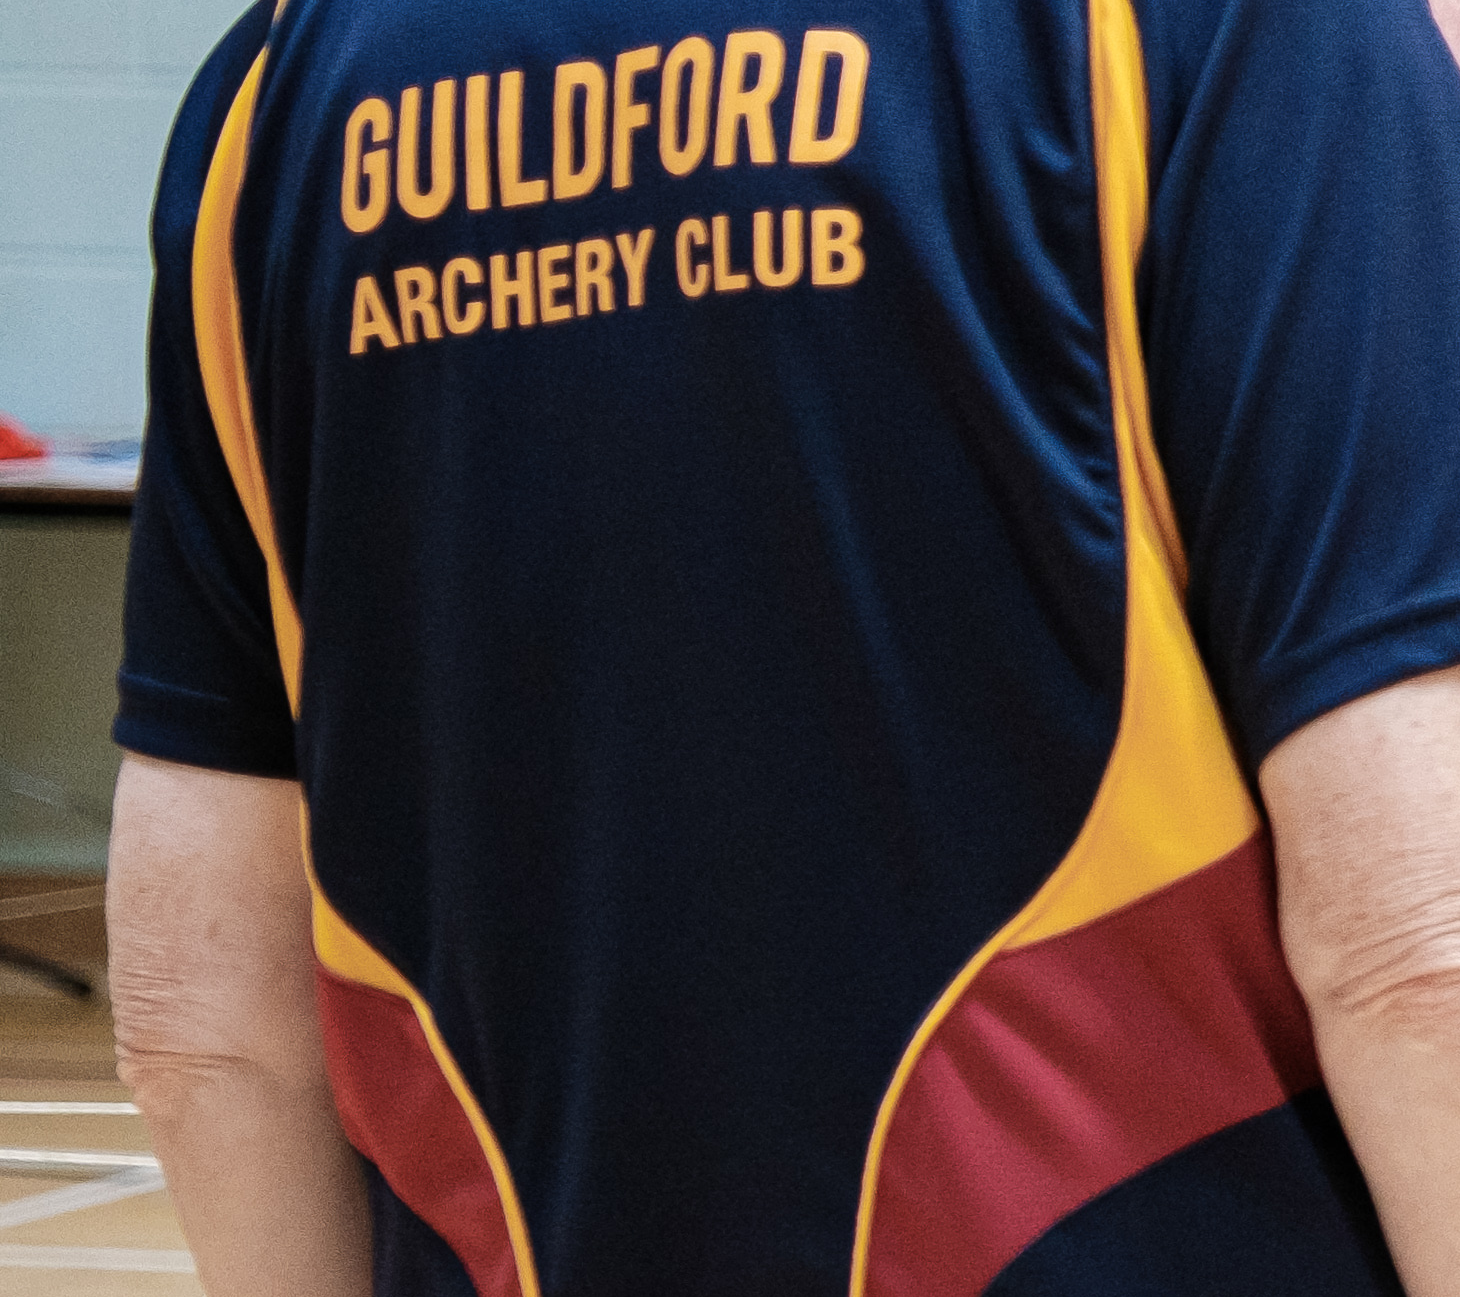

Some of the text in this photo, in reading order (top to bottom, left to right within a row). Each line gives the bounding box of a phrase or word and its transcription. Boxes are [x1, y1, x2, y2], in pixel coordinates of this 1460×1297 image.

[340, 28, 869, 235] GUILDFORD
[349, 207, 867, 356] ARCHERY CLUB
